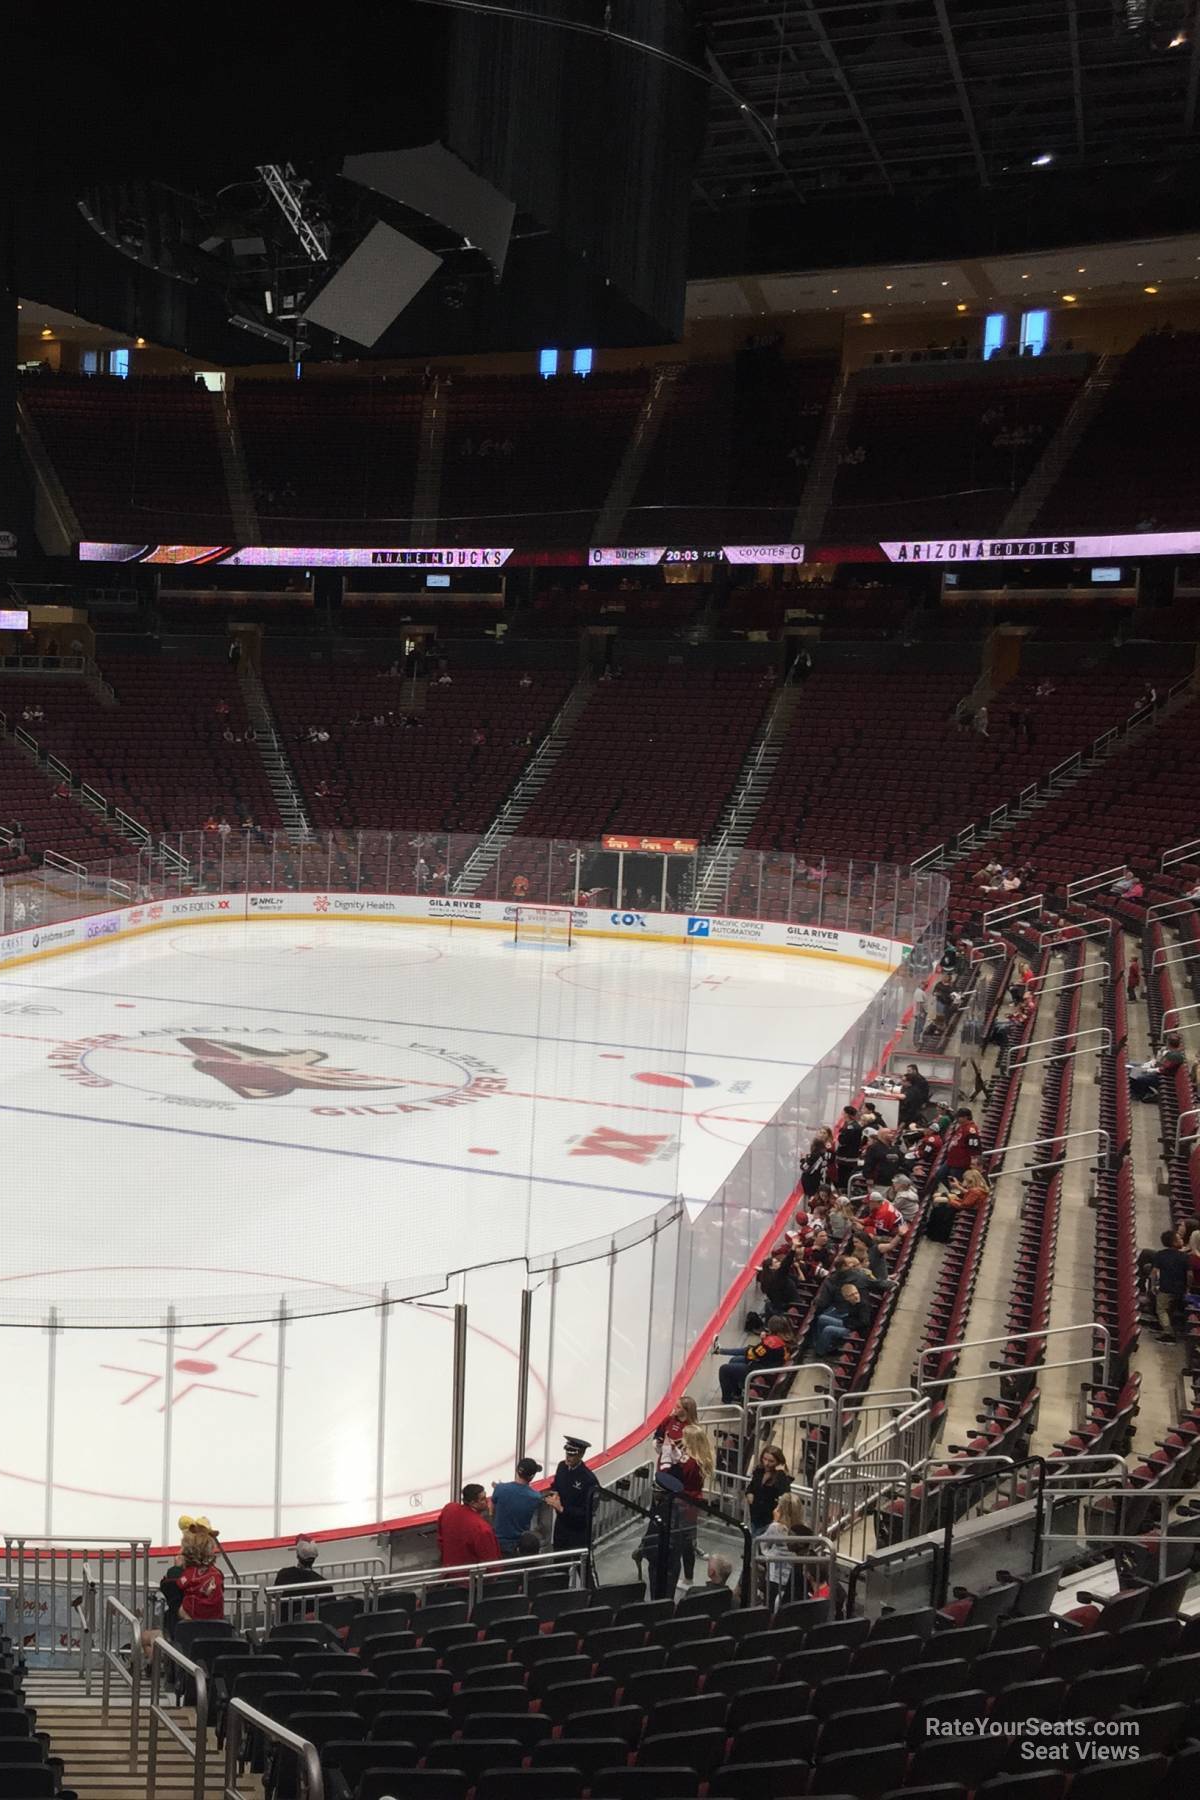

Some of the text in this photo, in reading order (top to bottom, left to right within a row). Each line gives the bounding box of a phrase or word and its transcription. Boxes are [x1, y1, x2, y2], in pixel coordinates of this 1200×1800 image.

[593, 549, 647, 562] 0 DUCKS
[666, 550, 698, 561] 20:03
[739, 546, 800, 560] COYOTES 0
[898, 540, 1070, 561] ARIZONA COYOTES
[376, 551, 501, 565] ANAHEIM DUCKS
[334, 899, 396, 911] Dignity Health
[429, 899, 482, 909] GILA RIVER
[712, 919, 764, 930] PACIFIC OFFICE
[712, 927, 761, 937] AUTOMATION
[787, 926, 839, 940] GILA RIVER
[428, 1076, 509, 1108] RIVER
[310, 1103, 434, 1117] GILA
